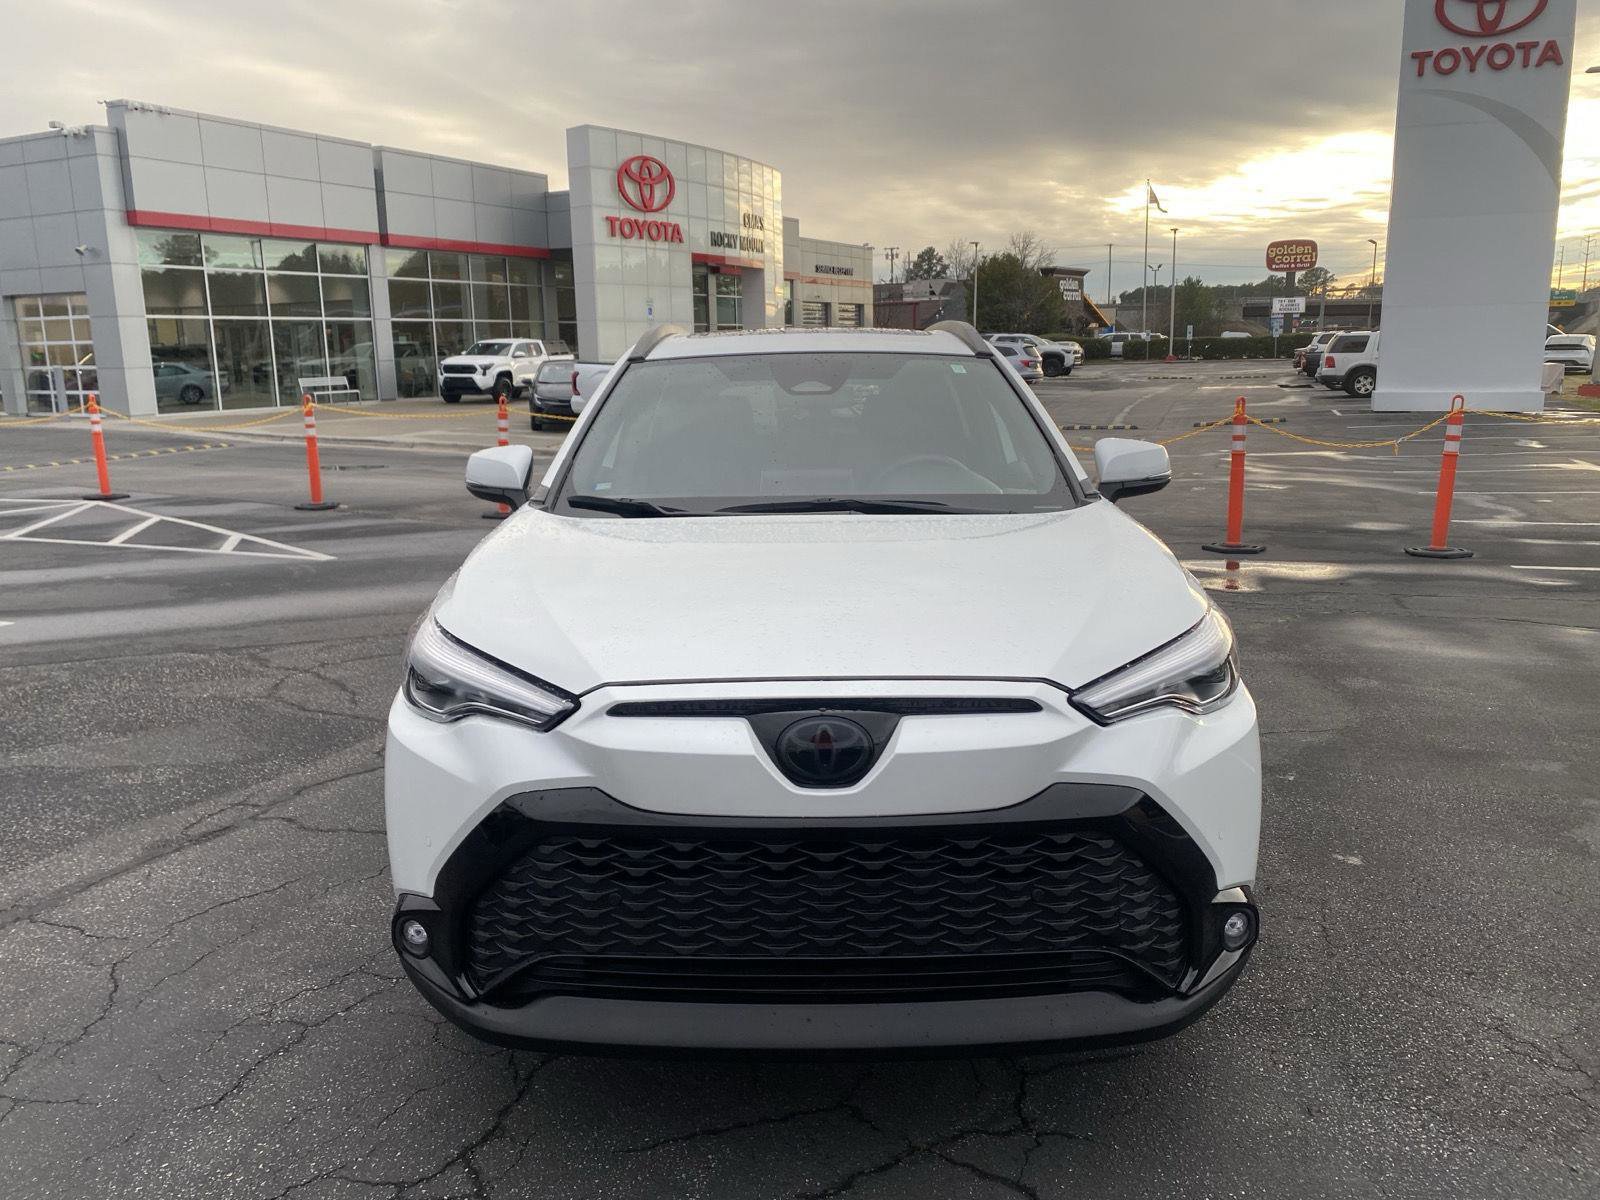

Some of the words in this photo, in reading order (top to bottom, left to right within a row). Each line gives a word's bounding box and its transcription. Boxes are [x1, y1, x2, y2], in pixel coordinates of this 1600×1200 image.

[1411, 40, 1563, 77] TOYOTA
[606, 216, 684, 244] TOYOTA
[710, 231, 738, 249] ROCKY
[1268, 244, 1312, 257] golden
[1275, 252, 1316, 264] corral
[1059, 278, 1079, 292] golden
[1063, 290, 1082, 301] corral
